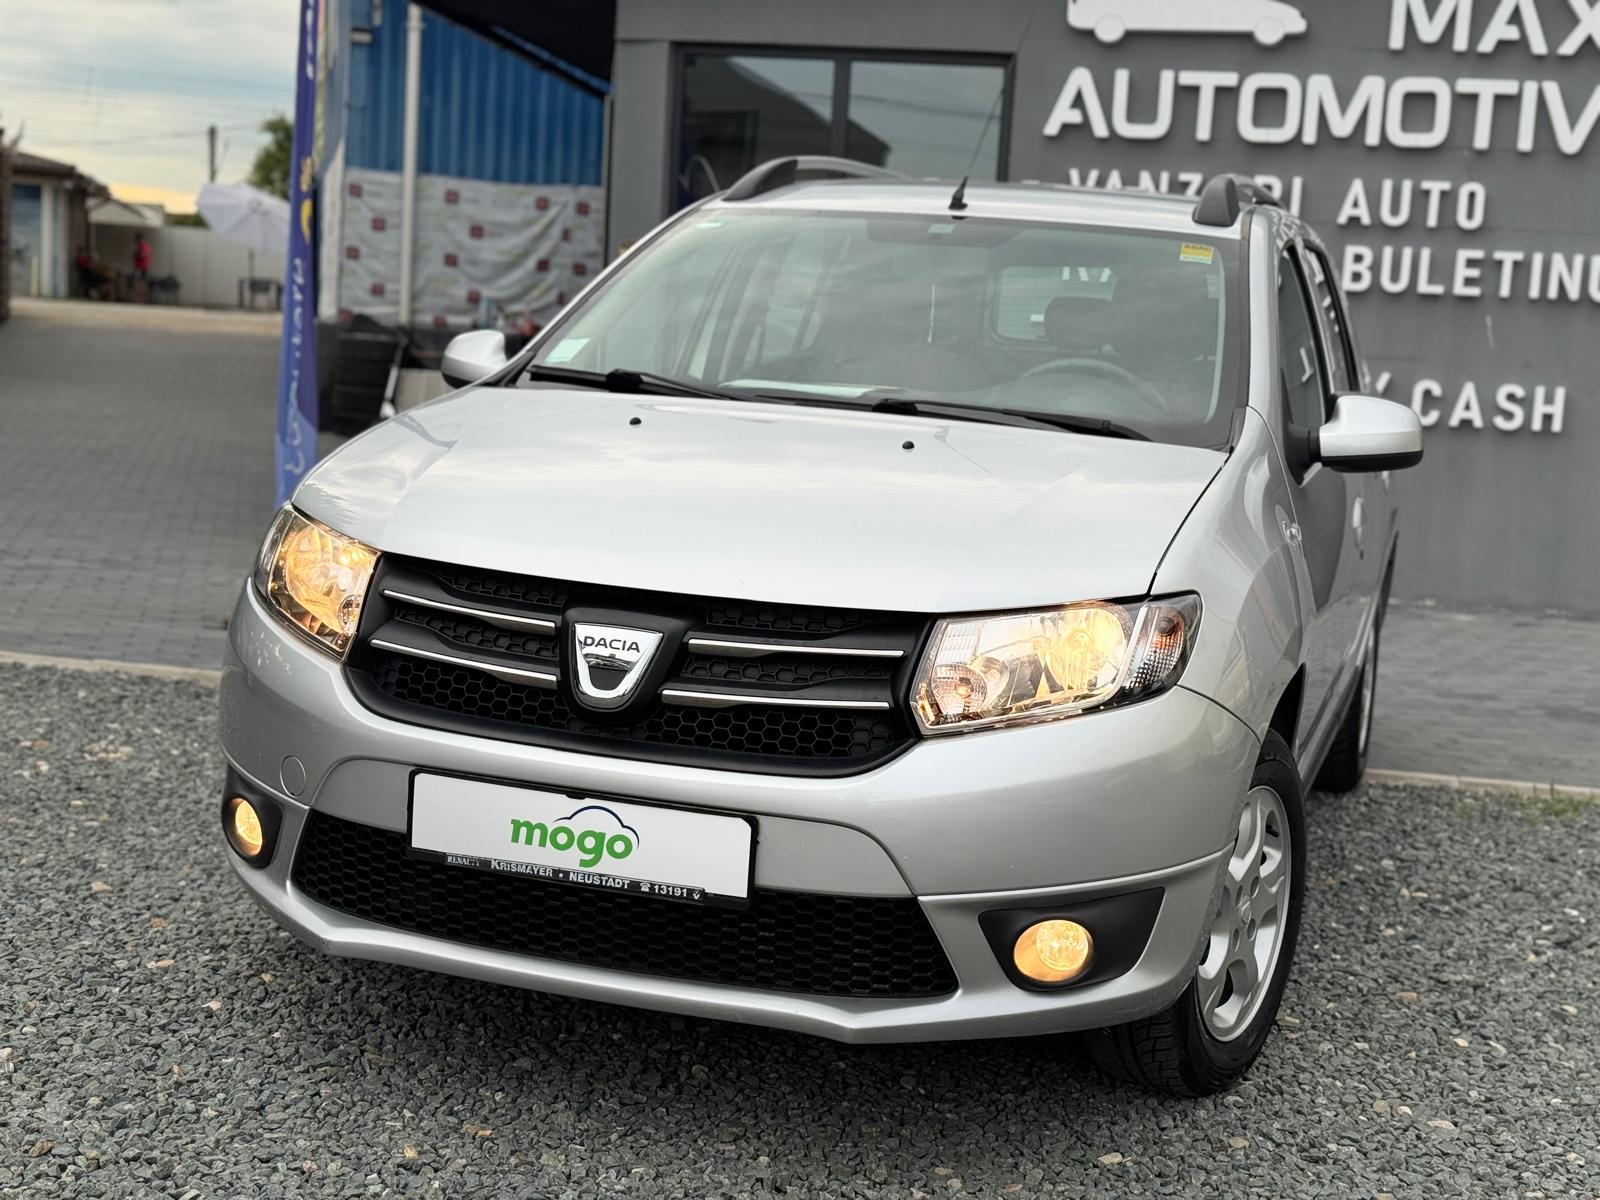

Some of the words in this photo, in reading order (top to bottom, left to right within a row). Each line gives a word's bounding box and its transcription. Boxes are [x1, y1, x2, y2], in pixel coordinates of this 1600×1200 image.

[1389, 0, 1600, 56] MAX
[1043, 66, 1600, 155] AUTOMOTIV
[1069, 168, 1303, 217] VANZI
[1337, 177, 1487, 231] AUTO
[1411, 379, 1566, 433] CASH
[583, 636, 640, 653] DACIA
[510, 819, 633, 867] mogo
[491, 859, 553, 877] KRISMAYER
[569, 872, 630, 889] NEUSTADT
[654, 885, 688, 897] 13191
